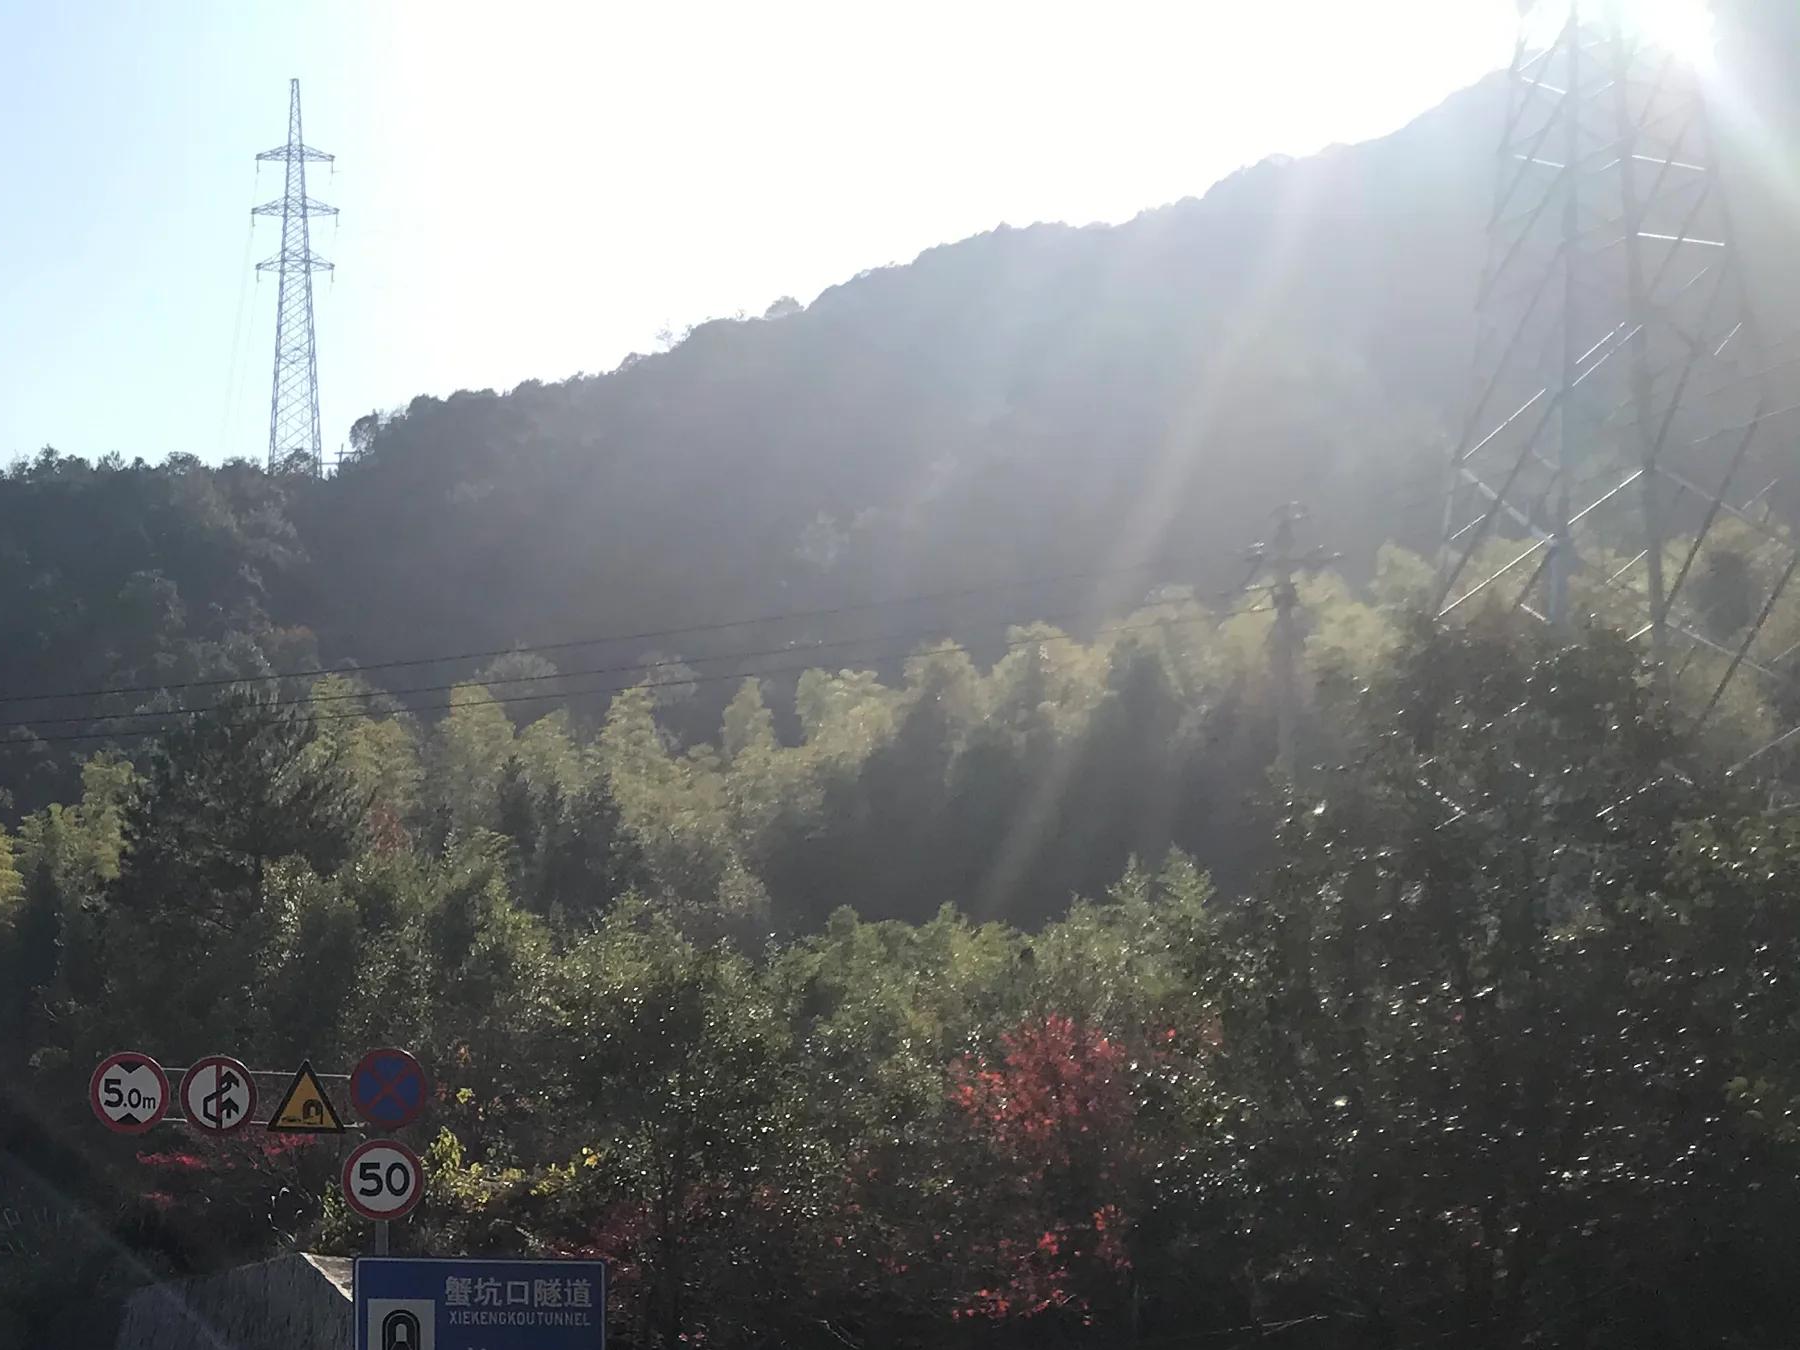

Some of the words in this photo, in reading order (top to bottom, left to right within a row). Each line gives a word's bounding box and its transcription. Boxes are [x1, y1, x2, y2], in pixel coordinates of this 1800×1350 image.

[103, 1078, 157, 1110] 5.0m
[359, 1161, 411, 1198] 50
[444, 1275, 593, 1308] 蟹坑口隧道
